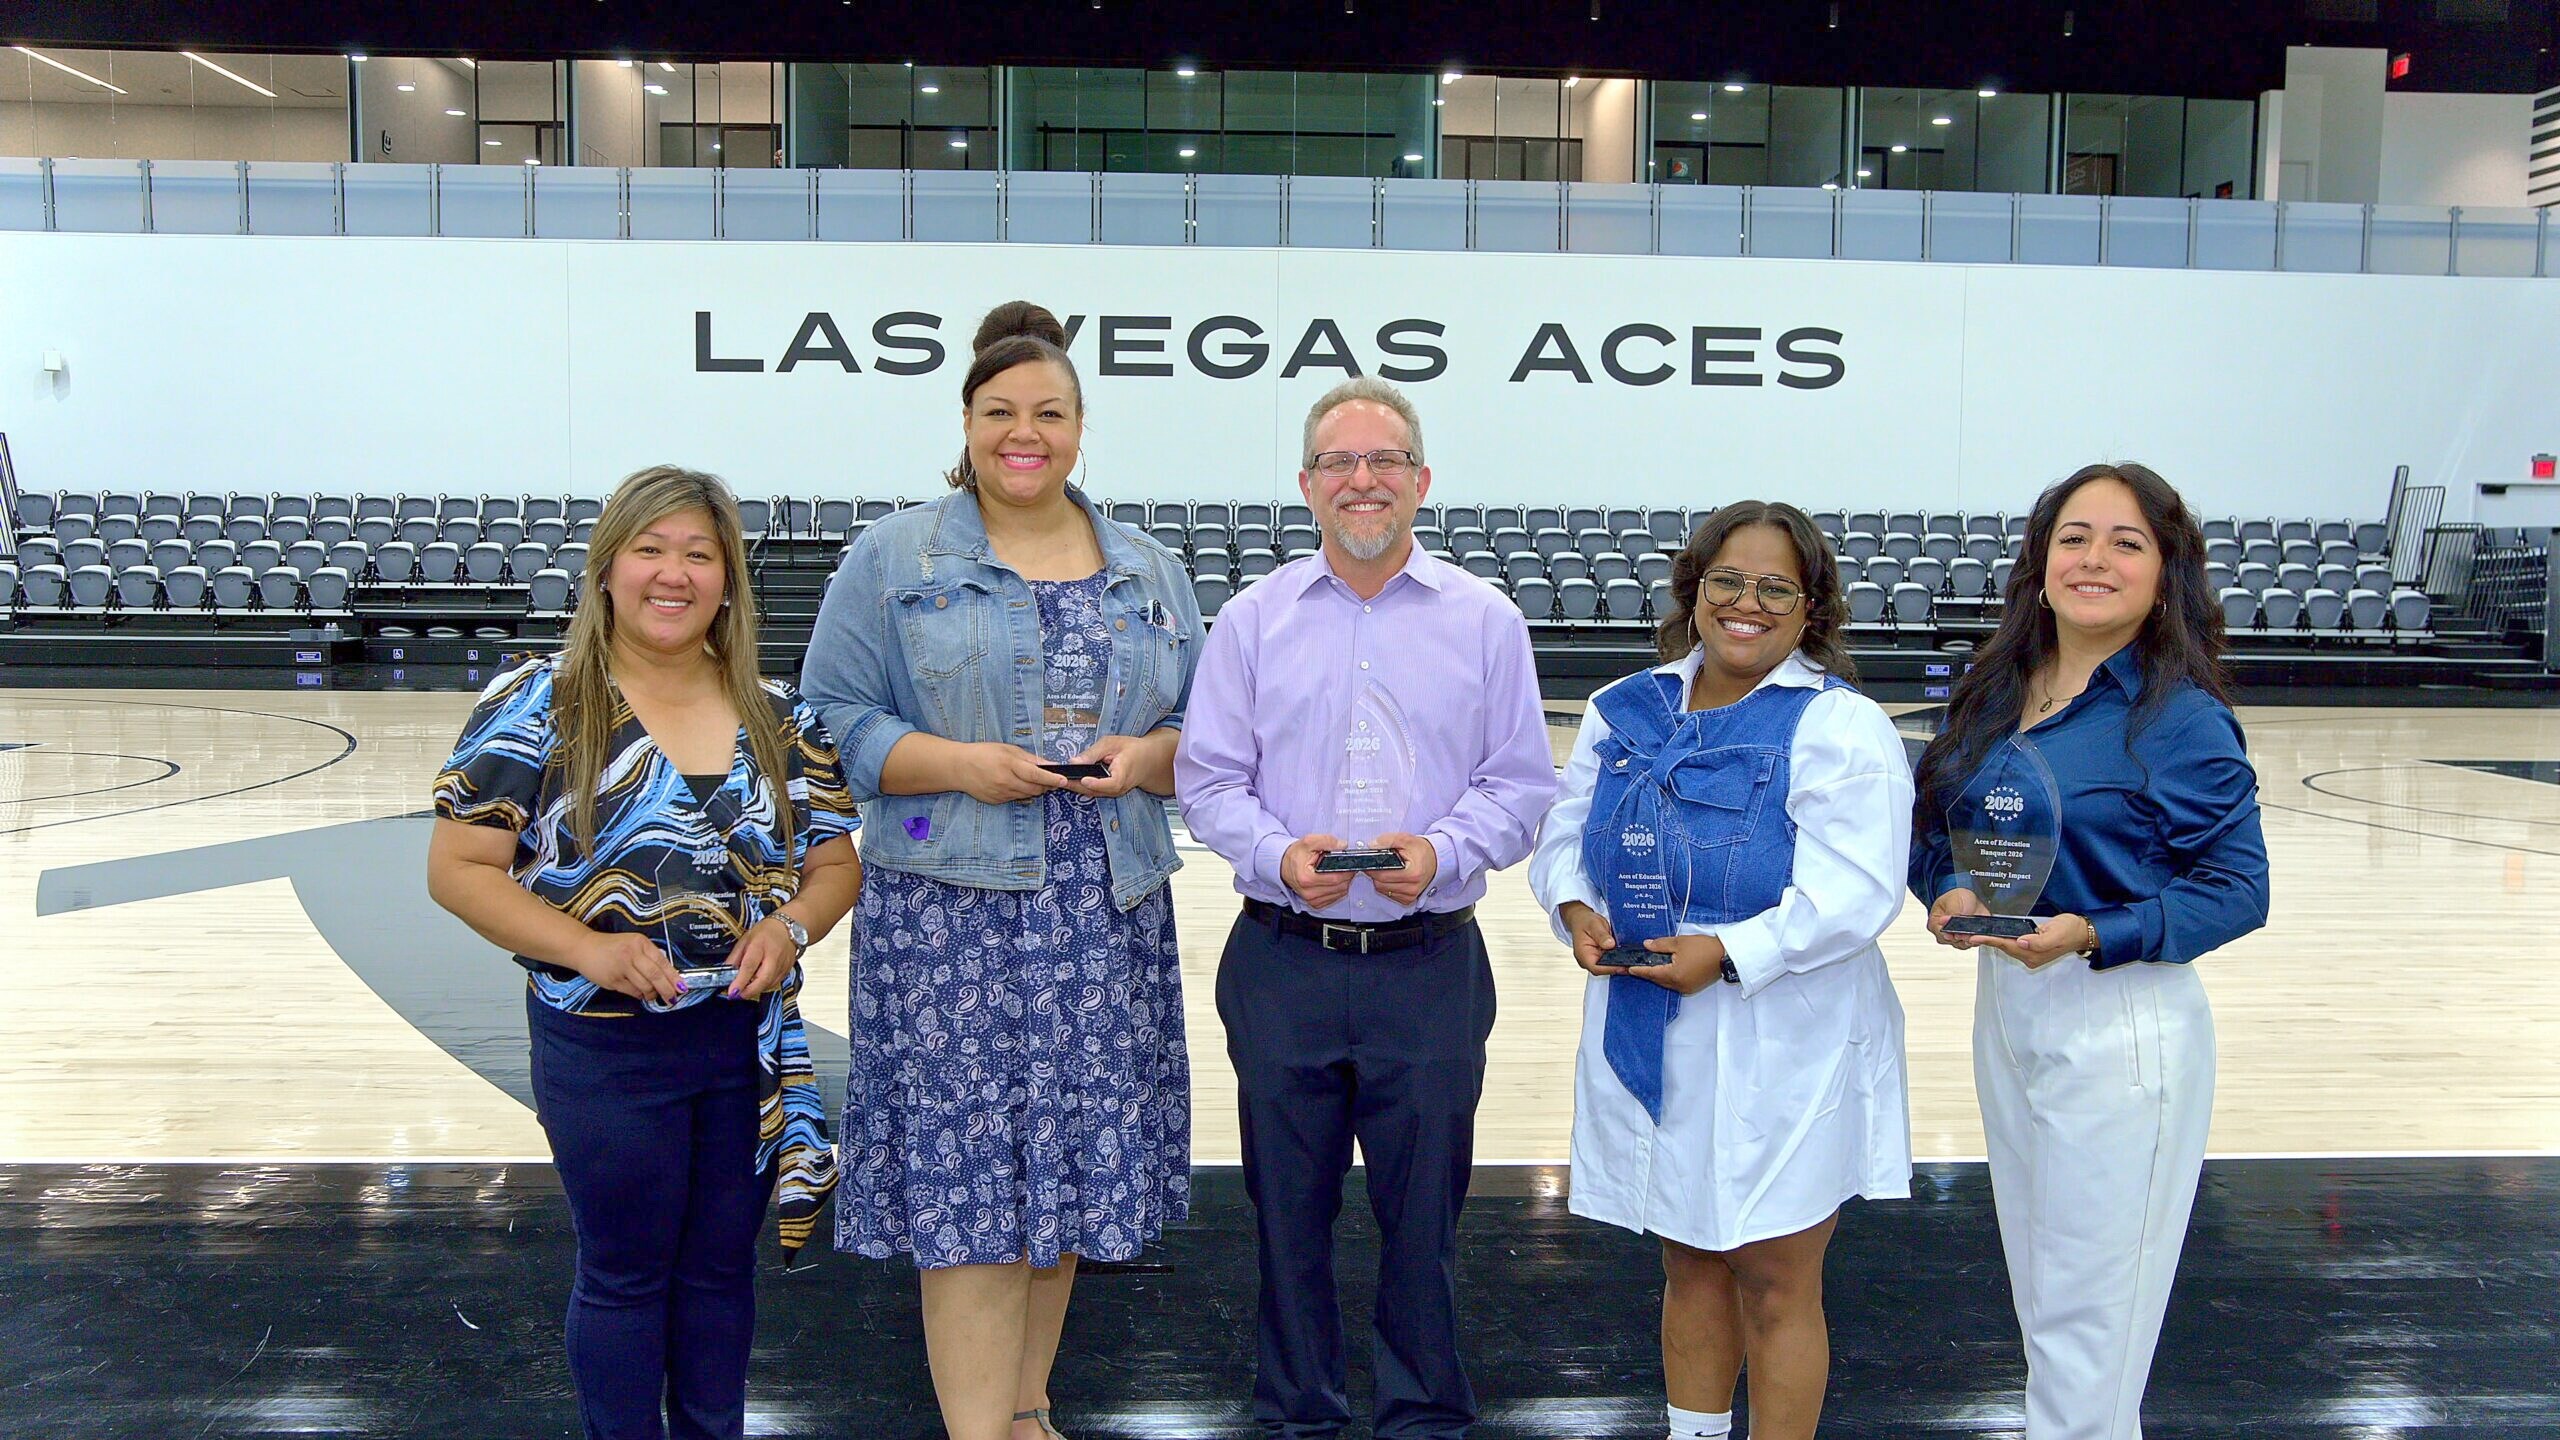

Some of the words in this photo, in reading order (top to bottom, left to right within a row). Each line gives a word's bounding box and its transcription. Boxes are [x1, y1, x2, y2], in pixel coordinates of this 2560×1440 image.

[696, 311, 945, 376] LAS
[1062, 314, 1448, 382] EGAS
[1508, 322, 1846, 390] ACES
[1053, 654, 1088, 667] 2026
[1345, 737, 1381, 751] 2026
[1984, 795, 2024, 812] 2026
[1621, 832, 1656, 847] 2026
[1998, 840, 2031, 848] Education
[692, 850, 729, 865] 2026
[1980, 848, 2007, 857] Banquet
[2008, 850, 2023, 858] 2026
[1970, 869, 2008, 879] Community
[2008, 872, 2032, 880] Impact
[1624, 882, 1648, 890] Banquet
[1989, 881, 2011, 889] Award
